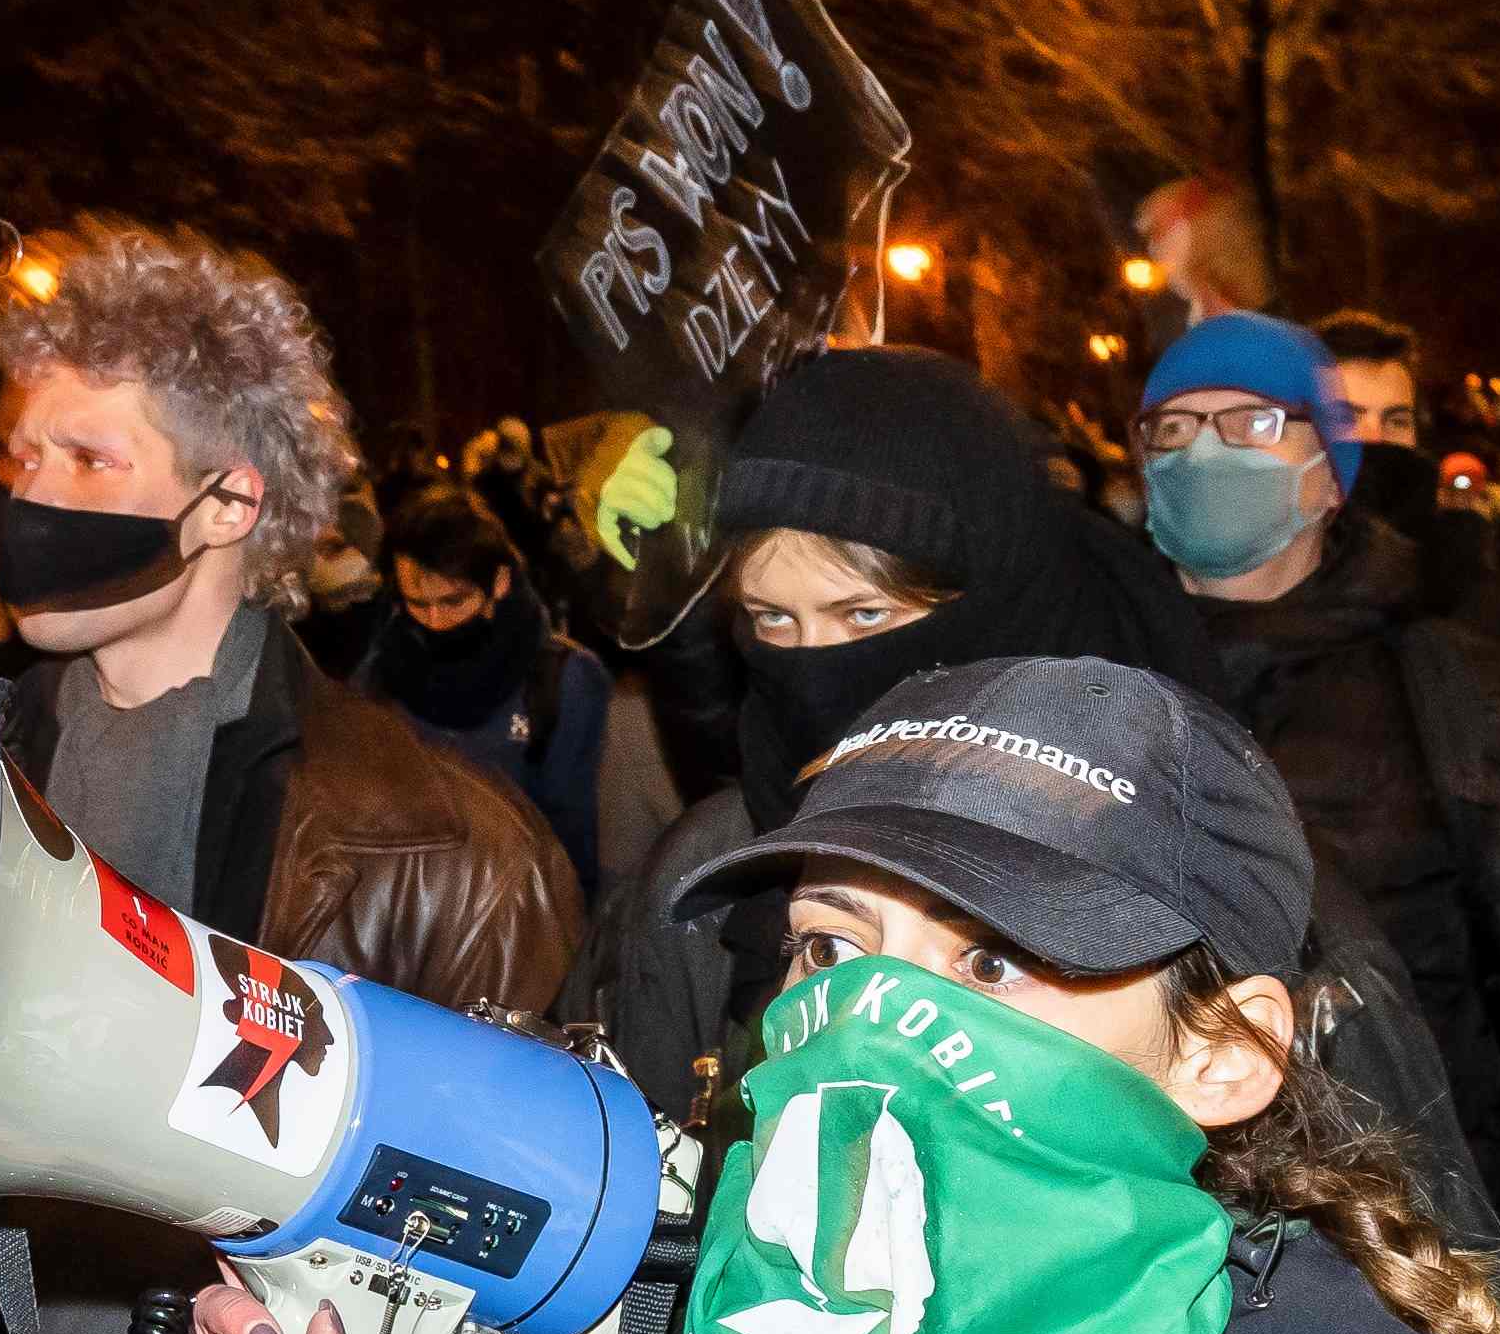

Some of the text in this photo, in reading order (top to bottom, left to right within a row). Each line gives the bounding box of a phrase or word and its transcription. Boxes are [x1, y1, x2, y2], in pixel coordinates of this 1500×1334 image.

[578, 186, 672, 352] PIS
[237, 972, 305, 1018] STRAJK
[242, 996, 306, 1042] KOBIET
[360, 1193, 375, 1209] M
[355, 1254, 387, 1273] USB/SD
